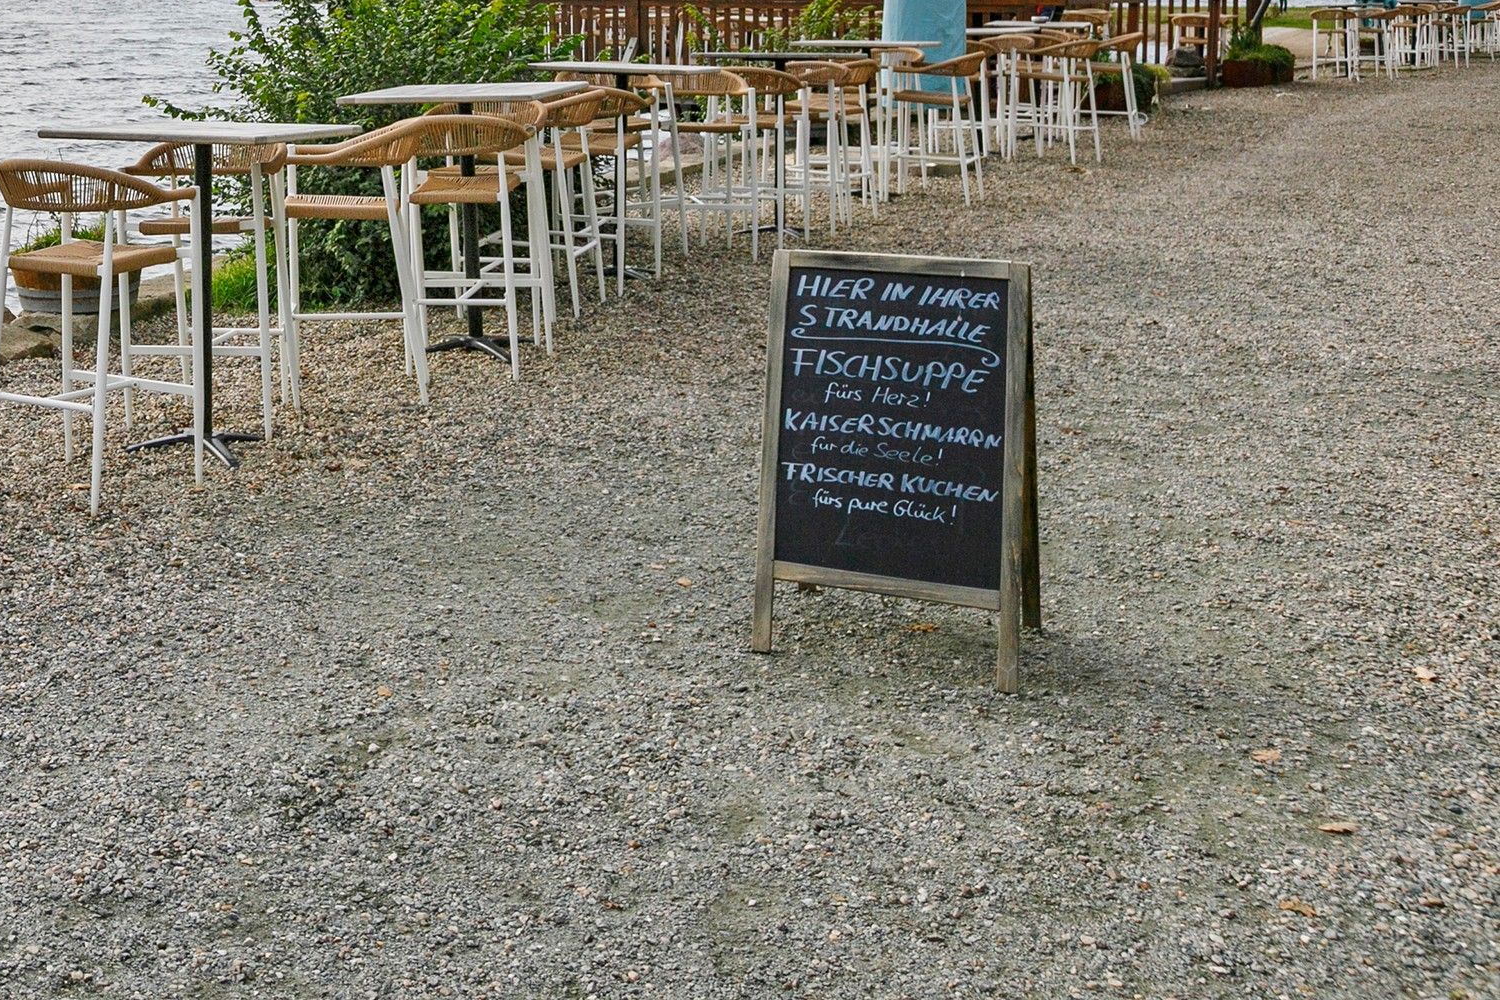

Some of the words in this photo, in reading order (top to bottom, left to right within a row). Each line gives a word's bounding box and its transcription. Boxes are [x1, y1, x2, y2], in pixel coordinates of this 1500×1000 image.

[796, 274, 875, 300] HIER
[880, 281, 915, 303] IN
[917, 285, 1000, 311] IHRER
[798, 304, 991, 343] STRANDHALLE
[791, 348, 991, 394] FISCHSUPPE
[824, 382, 863, 403] fürs
[871, 386, 931, 409] Herz!
[784, 407, 1002, 449] KAISERSCHMARRN
[840, 441, 869, 457] die
[873, 442, 943, 467] Seele!
[781, 461, 894, 491] FRISCHER
[900, 473, 999, 503] KUCHEN
[847, 498, 889, 515] pure
[893, 499, 957, 526] Glück!
